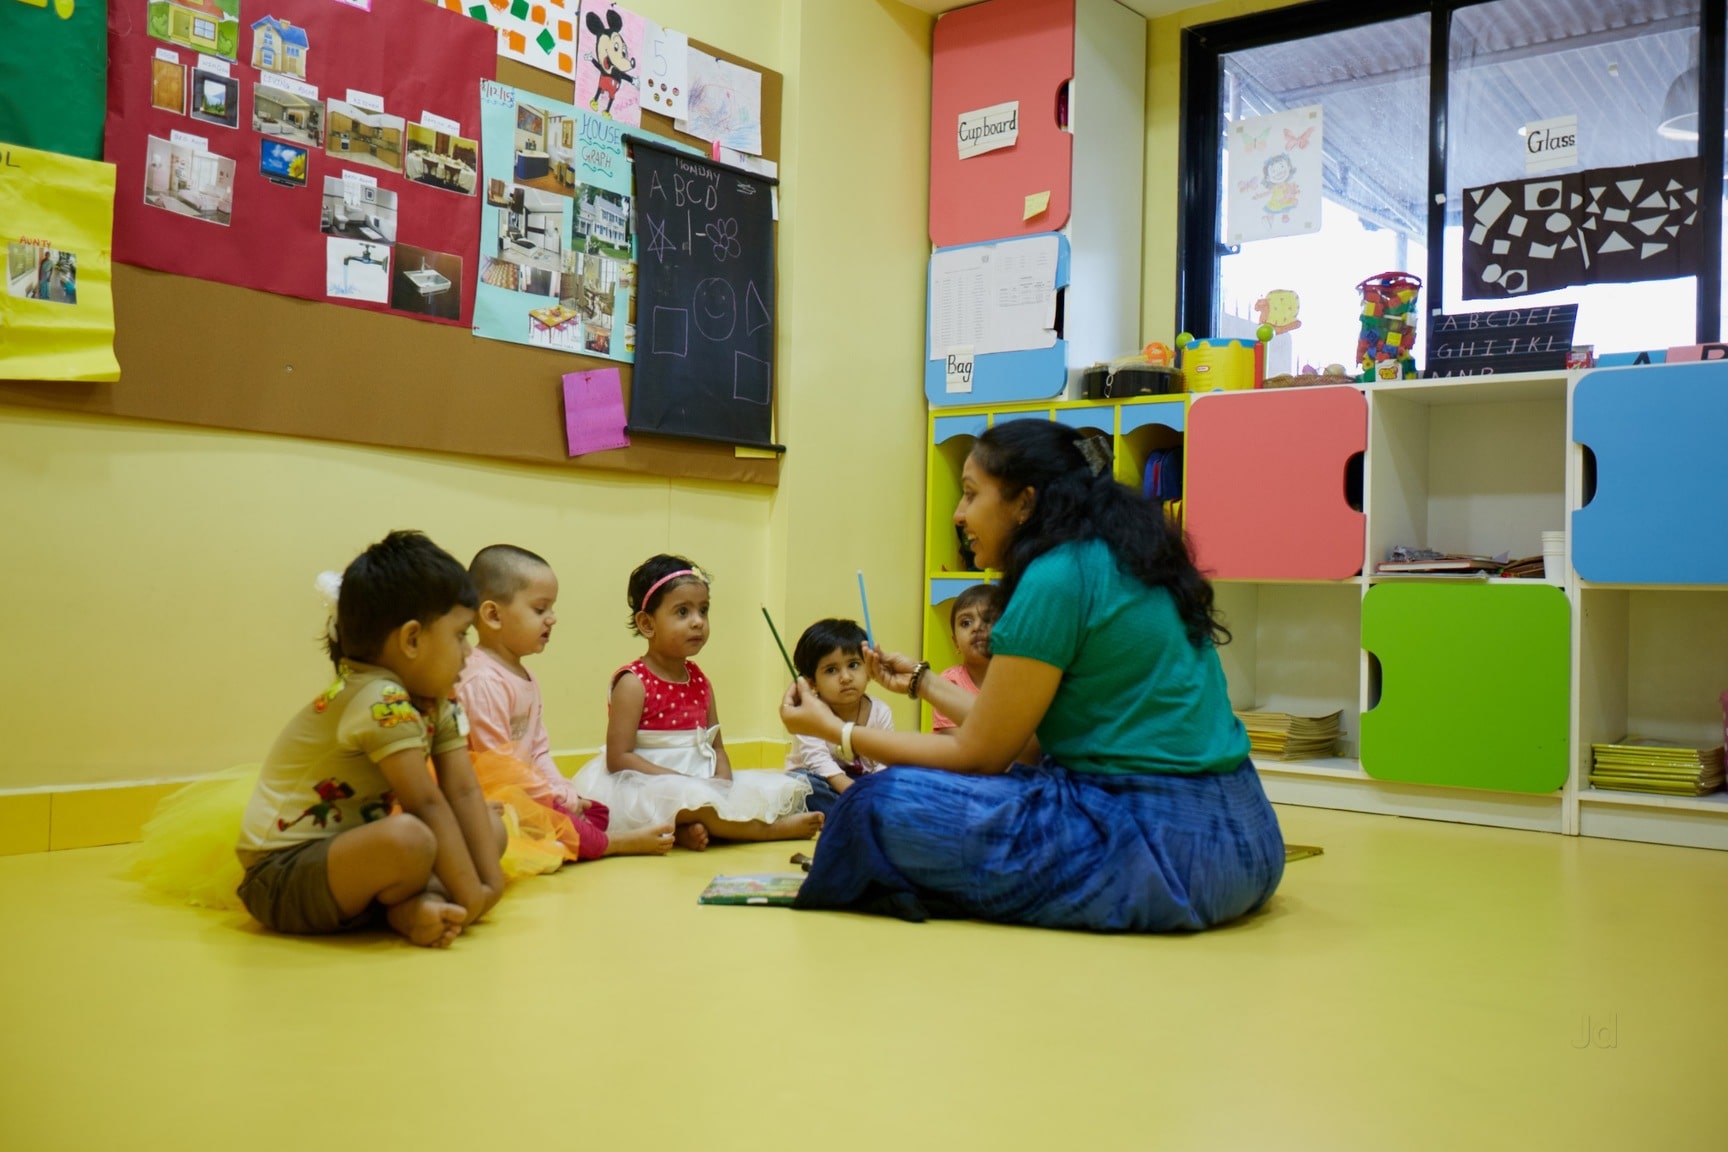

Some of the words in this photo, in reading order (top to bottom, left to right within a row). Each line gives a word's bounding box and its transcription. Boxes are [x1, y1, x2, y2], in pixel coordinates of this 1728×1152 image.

[579, 113, 621, 145] HOUSE
[959, 109, 1018, 146] Cupboard
[1527, 129, 1576, 154] Glass
[581, 145, 612, 169] GRAPH
[19, 236, 51, 249] AUNTY
[947, 354, 973, 382] Bag
